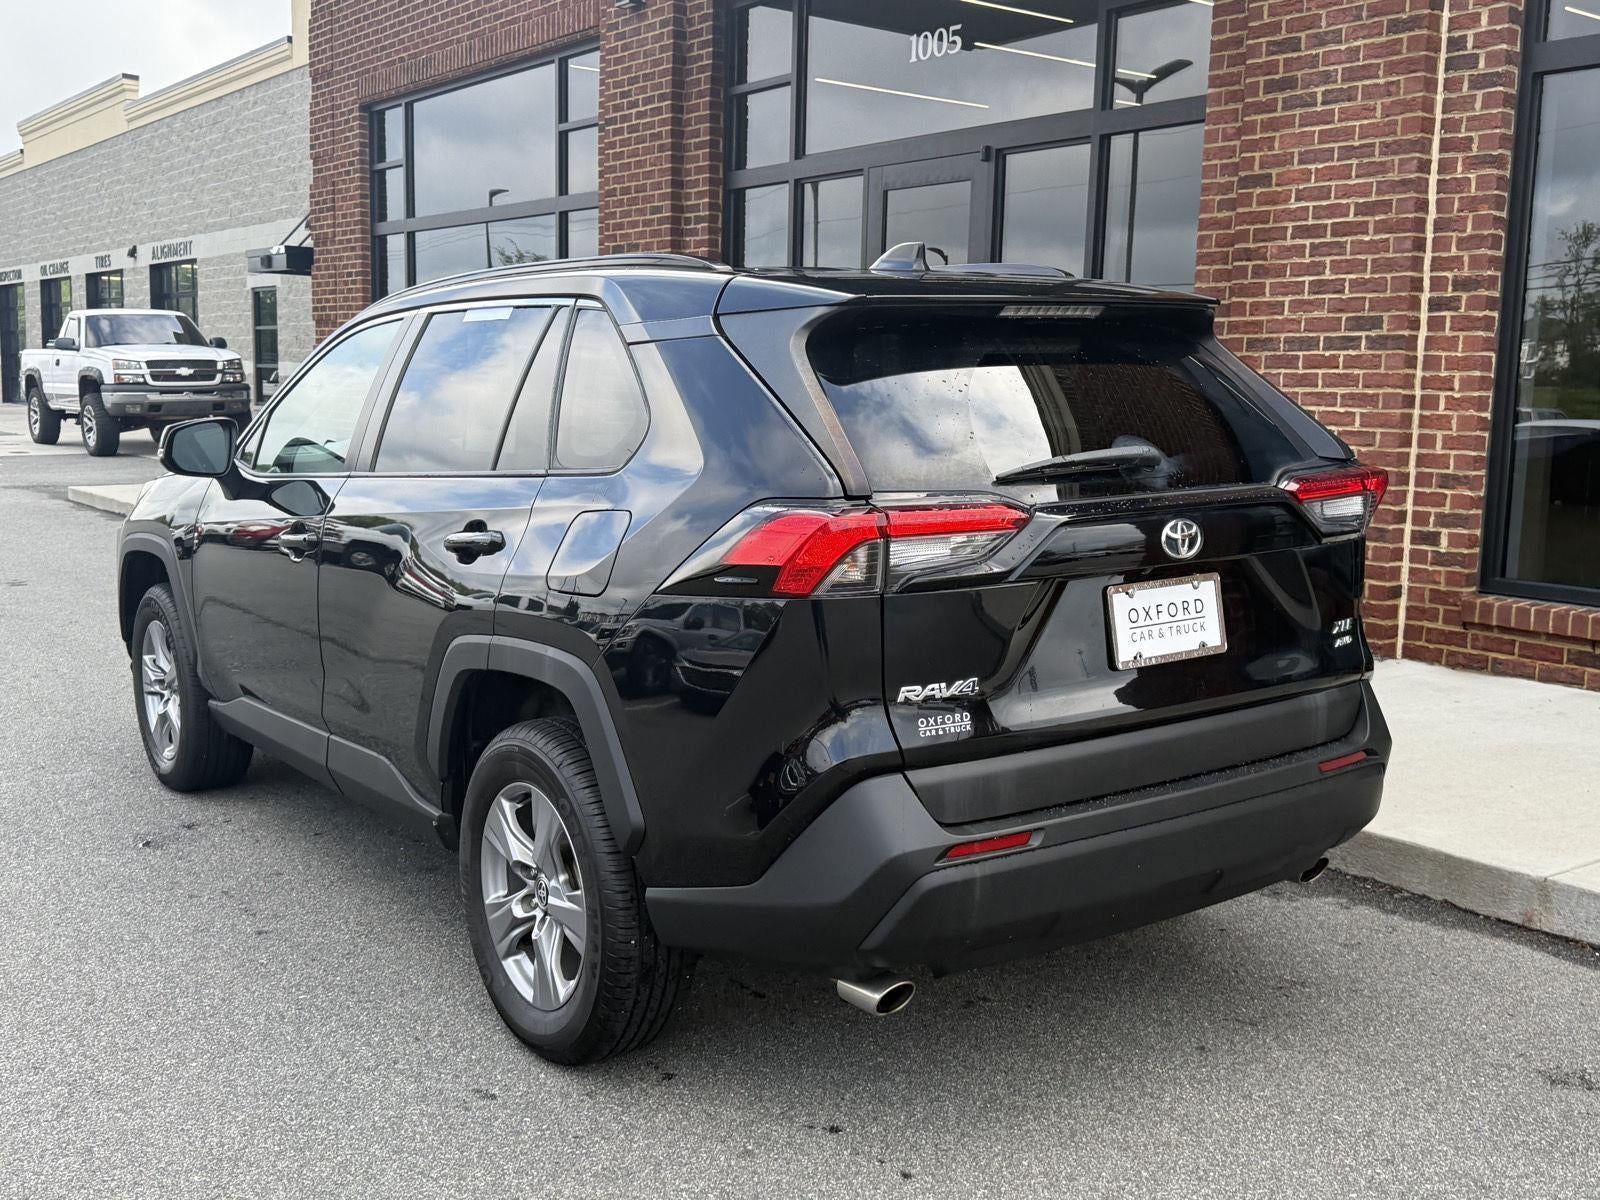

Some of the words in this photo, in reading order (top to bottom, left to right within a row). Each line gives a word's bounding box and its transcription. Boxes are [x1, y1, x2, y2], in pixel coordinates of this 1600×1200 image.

[909, 24, 962, 63] 1005
[151, 240, 193, 261] ALIGNMENT
[48, 261, 70, 276] CHANGE
[95, 254, 112, 269] TIRES
[1128, 598, 1204, 624] OXFORD
[1131, 629, 1154, 643] CAR
[1158, 627, 1165, 639] &
[1168, 621, 1206, 637] TRUCK
[897, 677, 979, 703] RAV4
[918, 712, 971, 727] OXFORD
[919, 729, 936, 737] CAR
[945, 724, 972, 733] TRUCK
